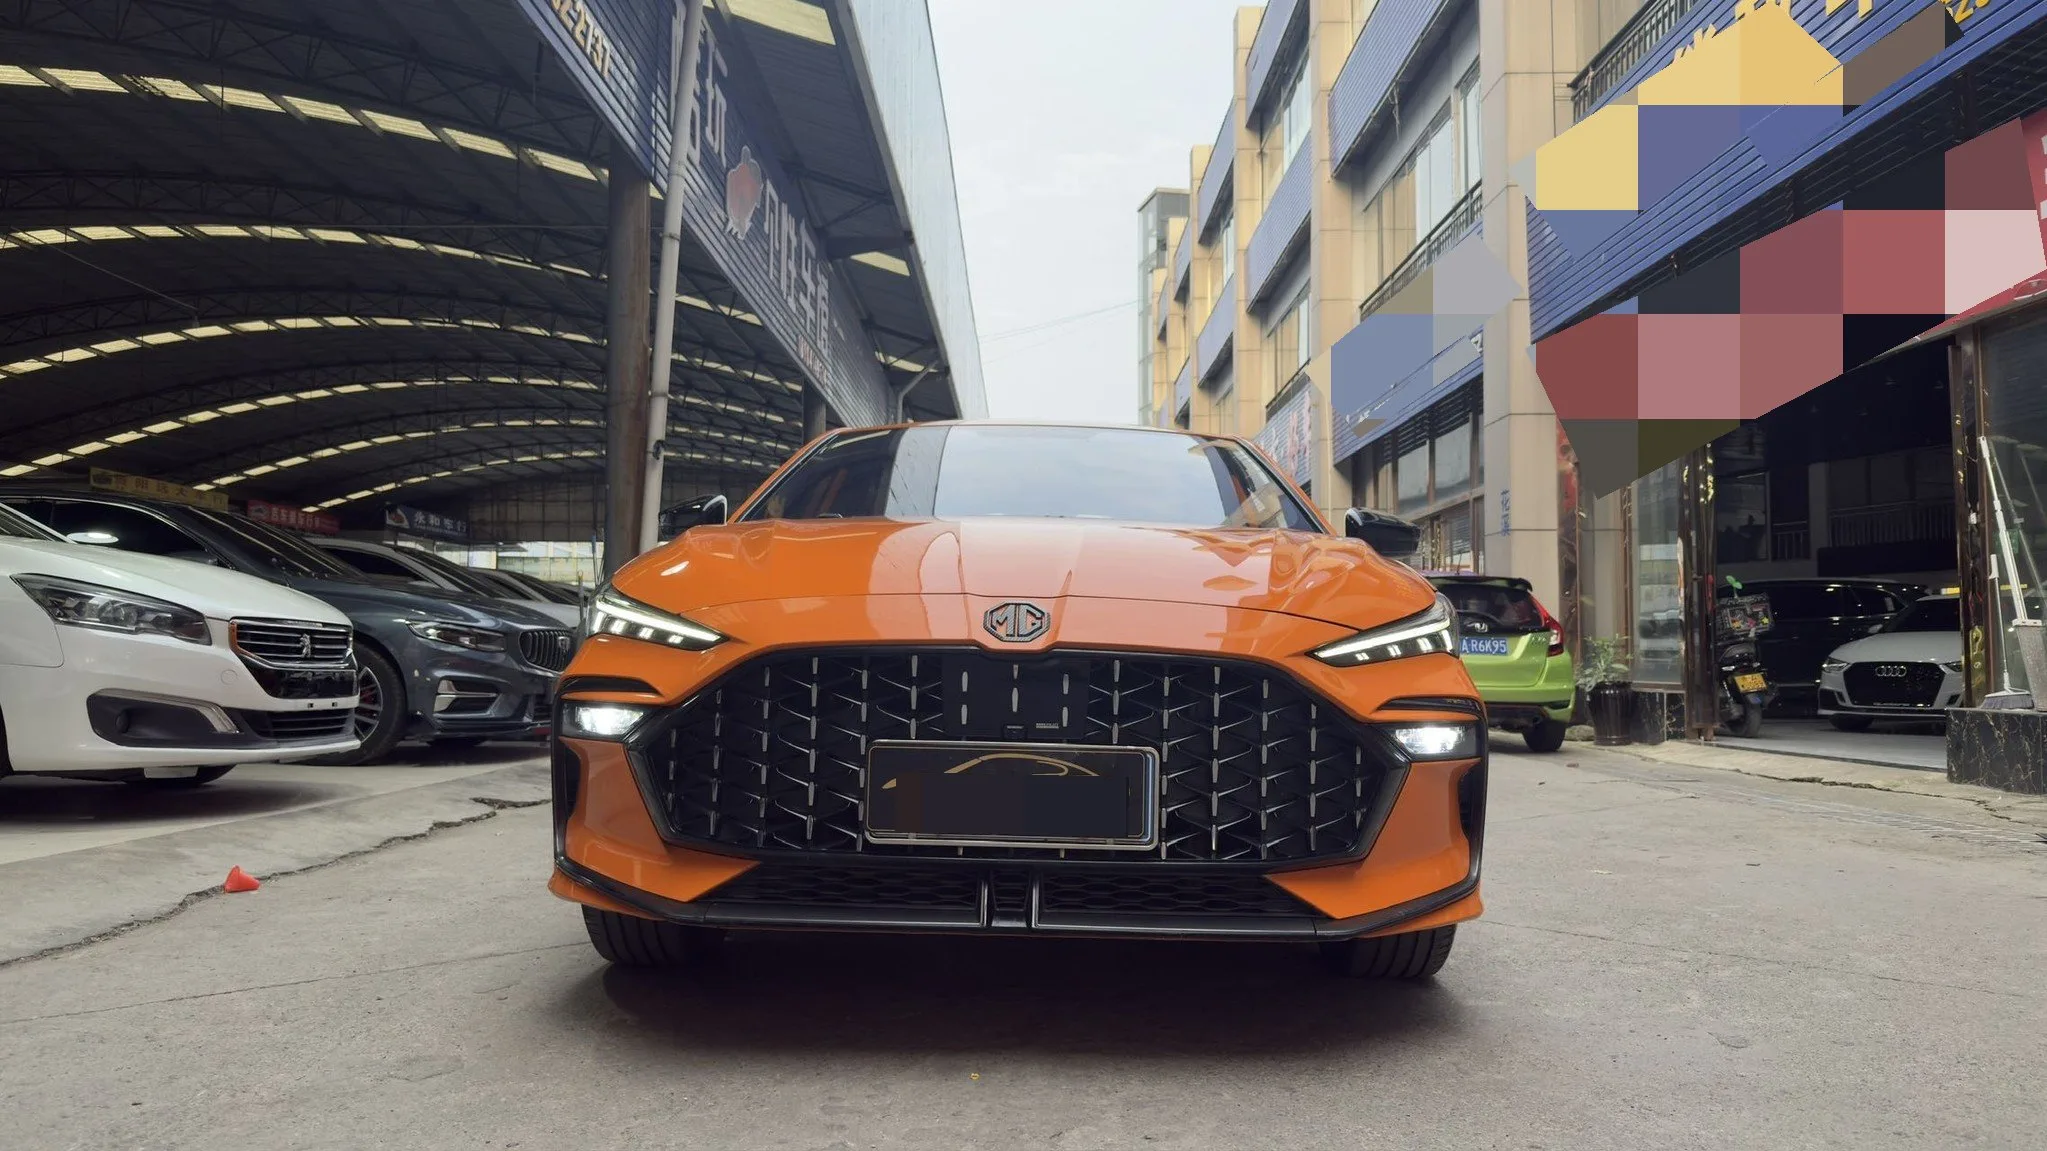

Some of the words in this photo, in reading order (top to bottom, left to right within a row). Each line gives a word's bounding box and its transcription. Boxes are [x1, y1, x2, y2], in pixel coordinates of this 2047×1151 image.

[415, 511, 467, 533] 永和车行
[988, 602, 1045, 639] MG
